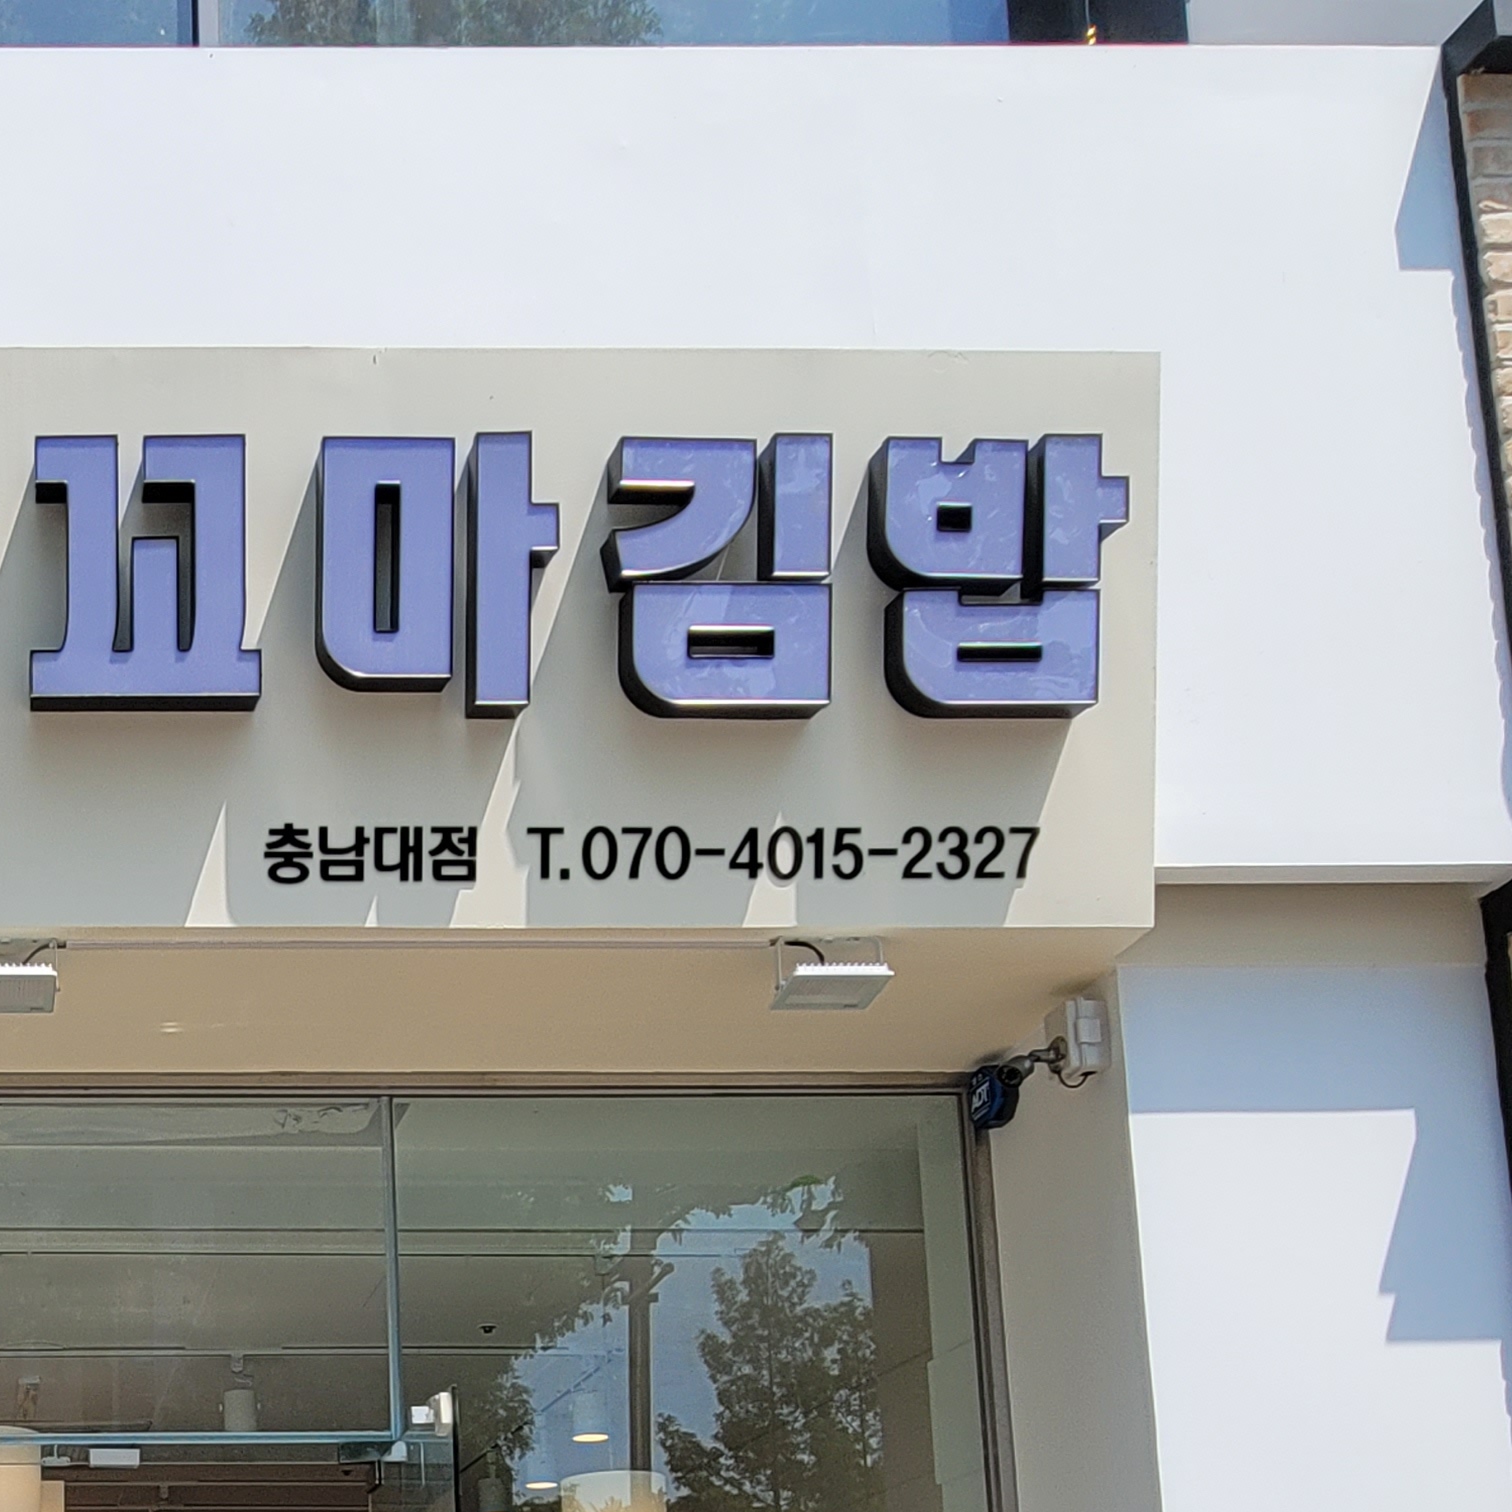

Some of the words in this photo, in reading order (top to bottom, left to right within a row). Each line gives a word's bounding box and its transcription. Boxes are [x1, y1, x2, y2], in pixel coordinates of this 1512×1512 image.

[29, 430, 1131, 720] 꼬마김밥
[263, 823, 479, 884] 충남대점
[526, 824, 1042, 882] T.070-4015-2327
